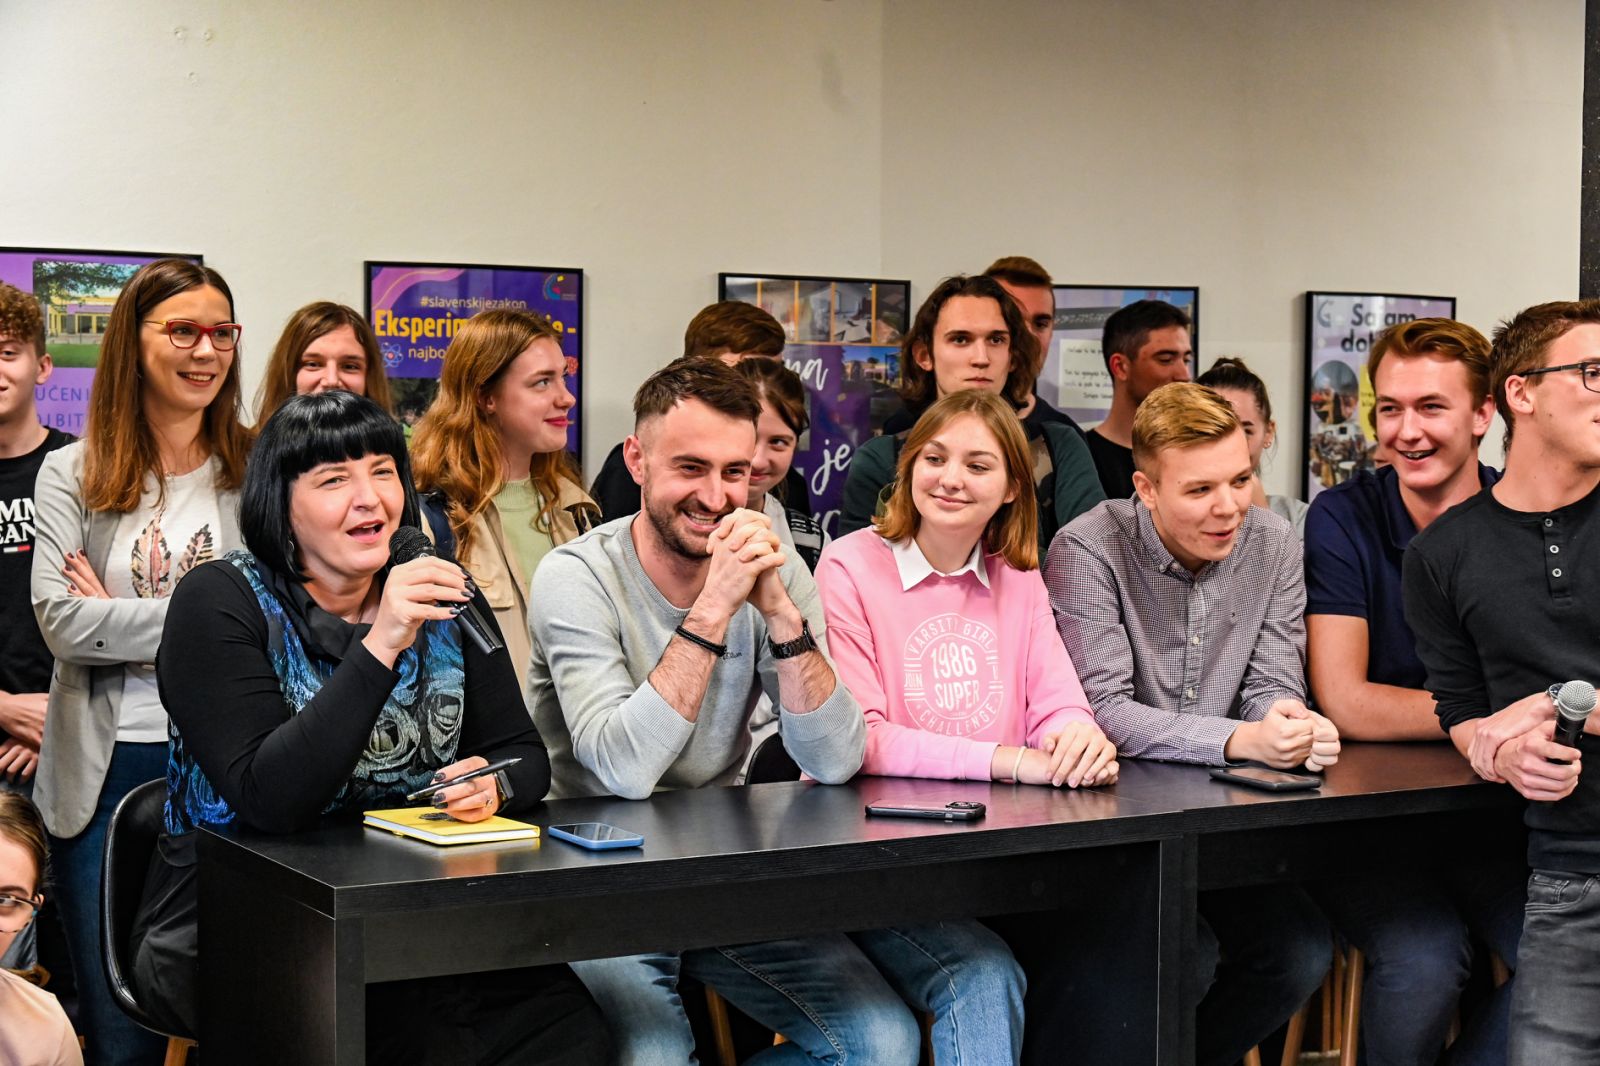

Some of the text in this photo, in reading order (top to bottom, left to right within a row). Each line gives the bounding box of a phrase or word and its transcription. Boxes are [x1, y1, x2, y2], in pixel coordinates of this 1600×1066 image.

[811, 439, 852, 495] je
[930, 641, 977, 679] 1986
[934, 679, 980, 711] SUPER
[919, 702, 998, 736] CHALLENGE
